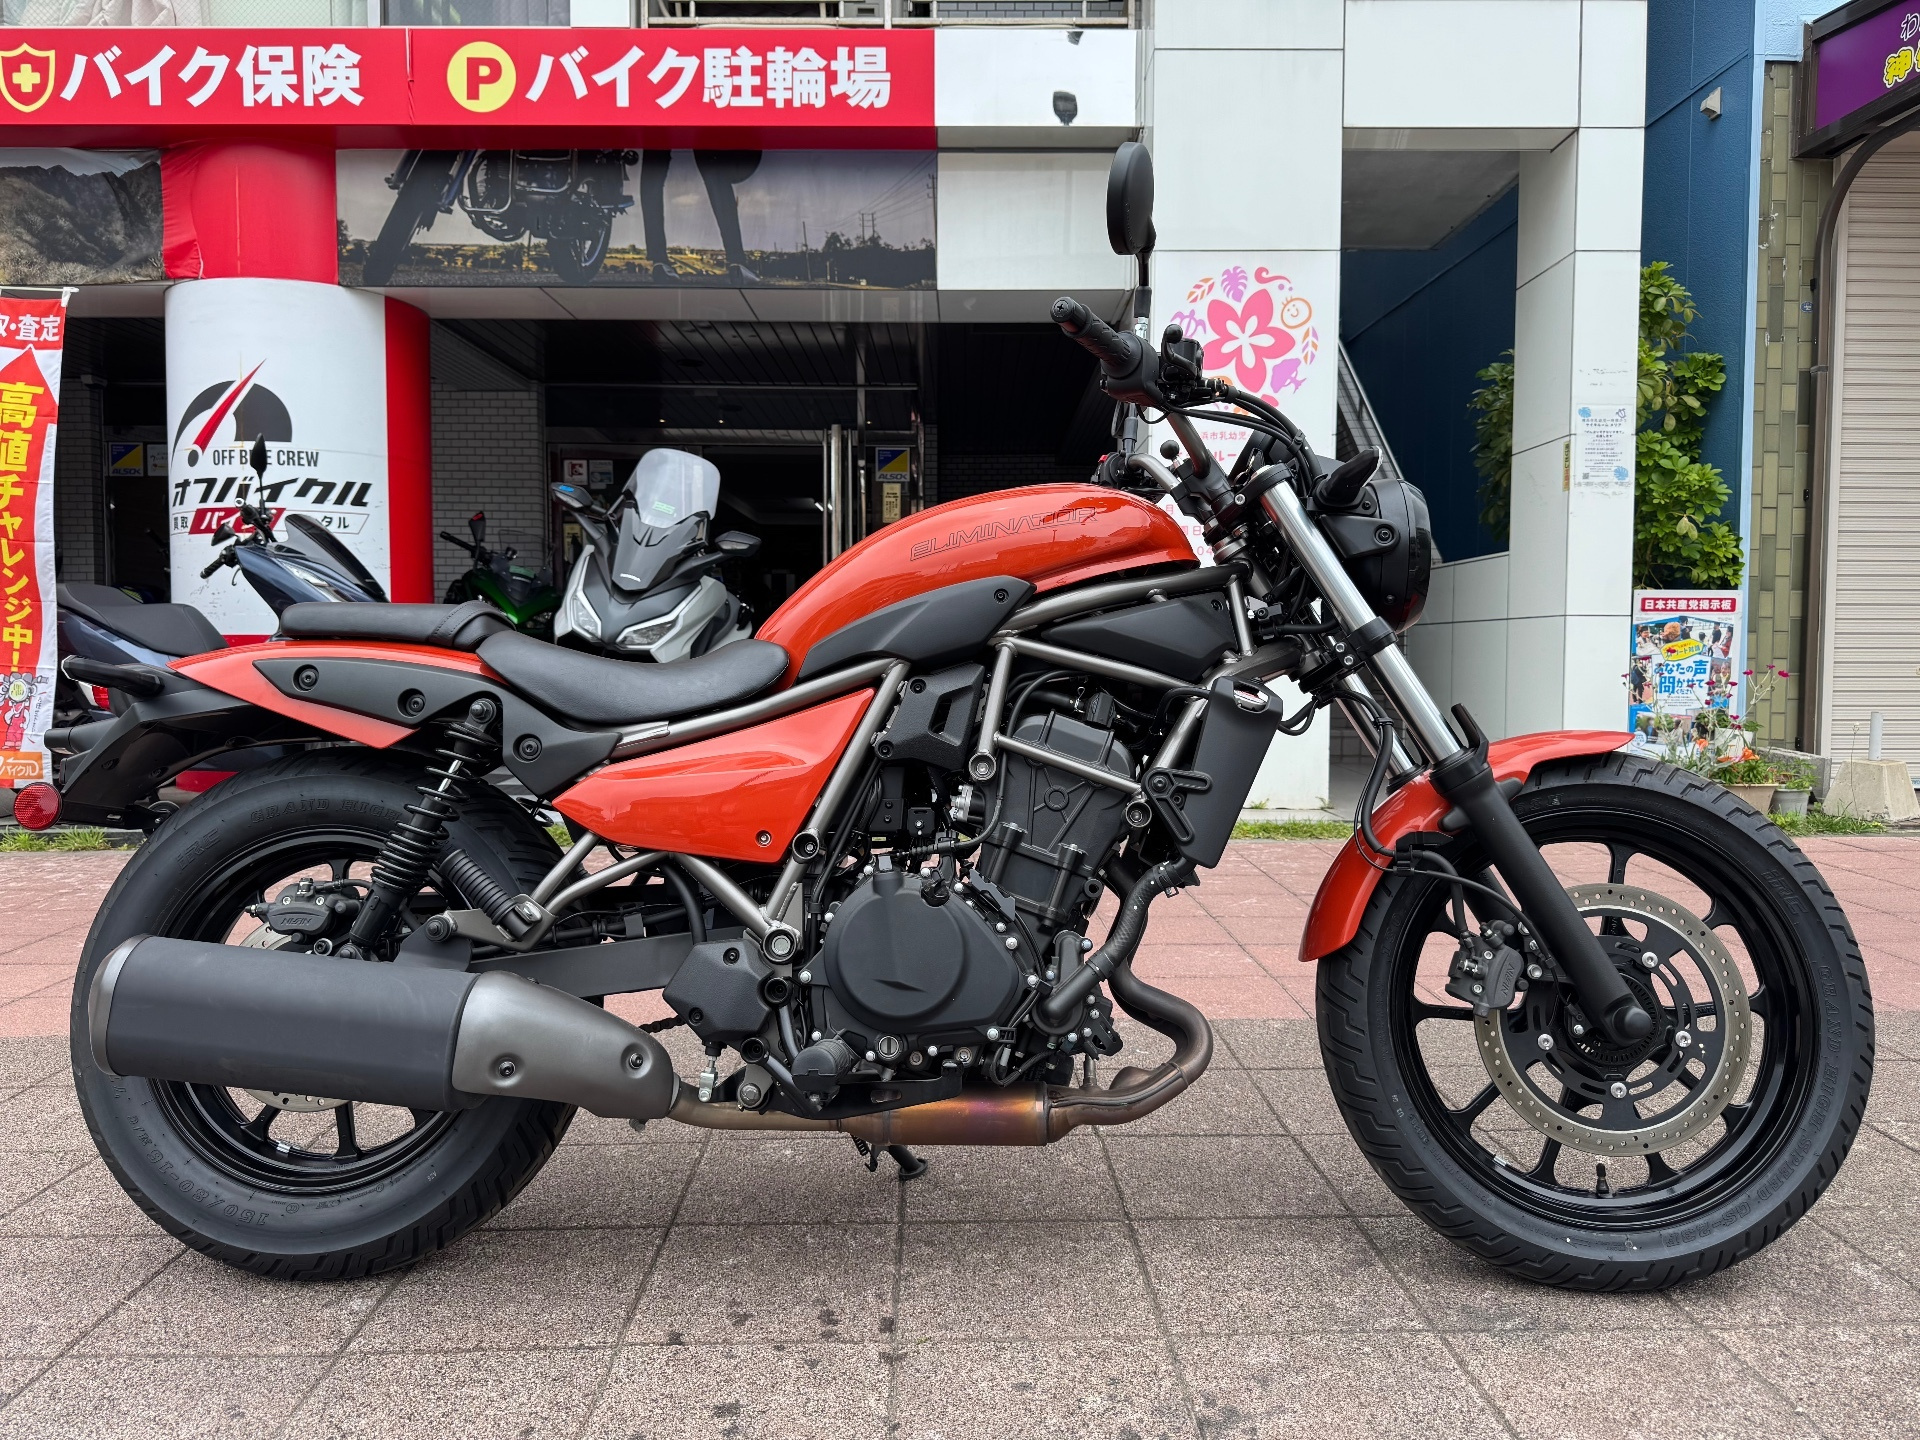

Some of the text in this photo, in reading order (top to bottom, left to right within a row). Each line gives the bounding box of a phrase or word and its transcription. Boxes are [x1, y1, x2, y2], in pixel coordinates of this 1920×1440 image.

[1900, 13, 1920, 41] わ
[60, 44, 365, 107] バイク保険
[466, 46, 891, 109] P バイク駐輪場
[1201, 431, 1247, 440] 浜市乳幼児
[213, 450, 319, 467] OFF BE CREW
[172, 476, 373, 508] オフバイクル
[173, 516, 189, 531] 買取
[200, 511, 254, 531] バイ
[320, 516, 349, 530] タル
[910, 506, 1098, 561] ELIMINATOR
[1644, 599, 1732, 611] 日本共産党掲示板
[1817, 964, 1843, 1053] GRAND
